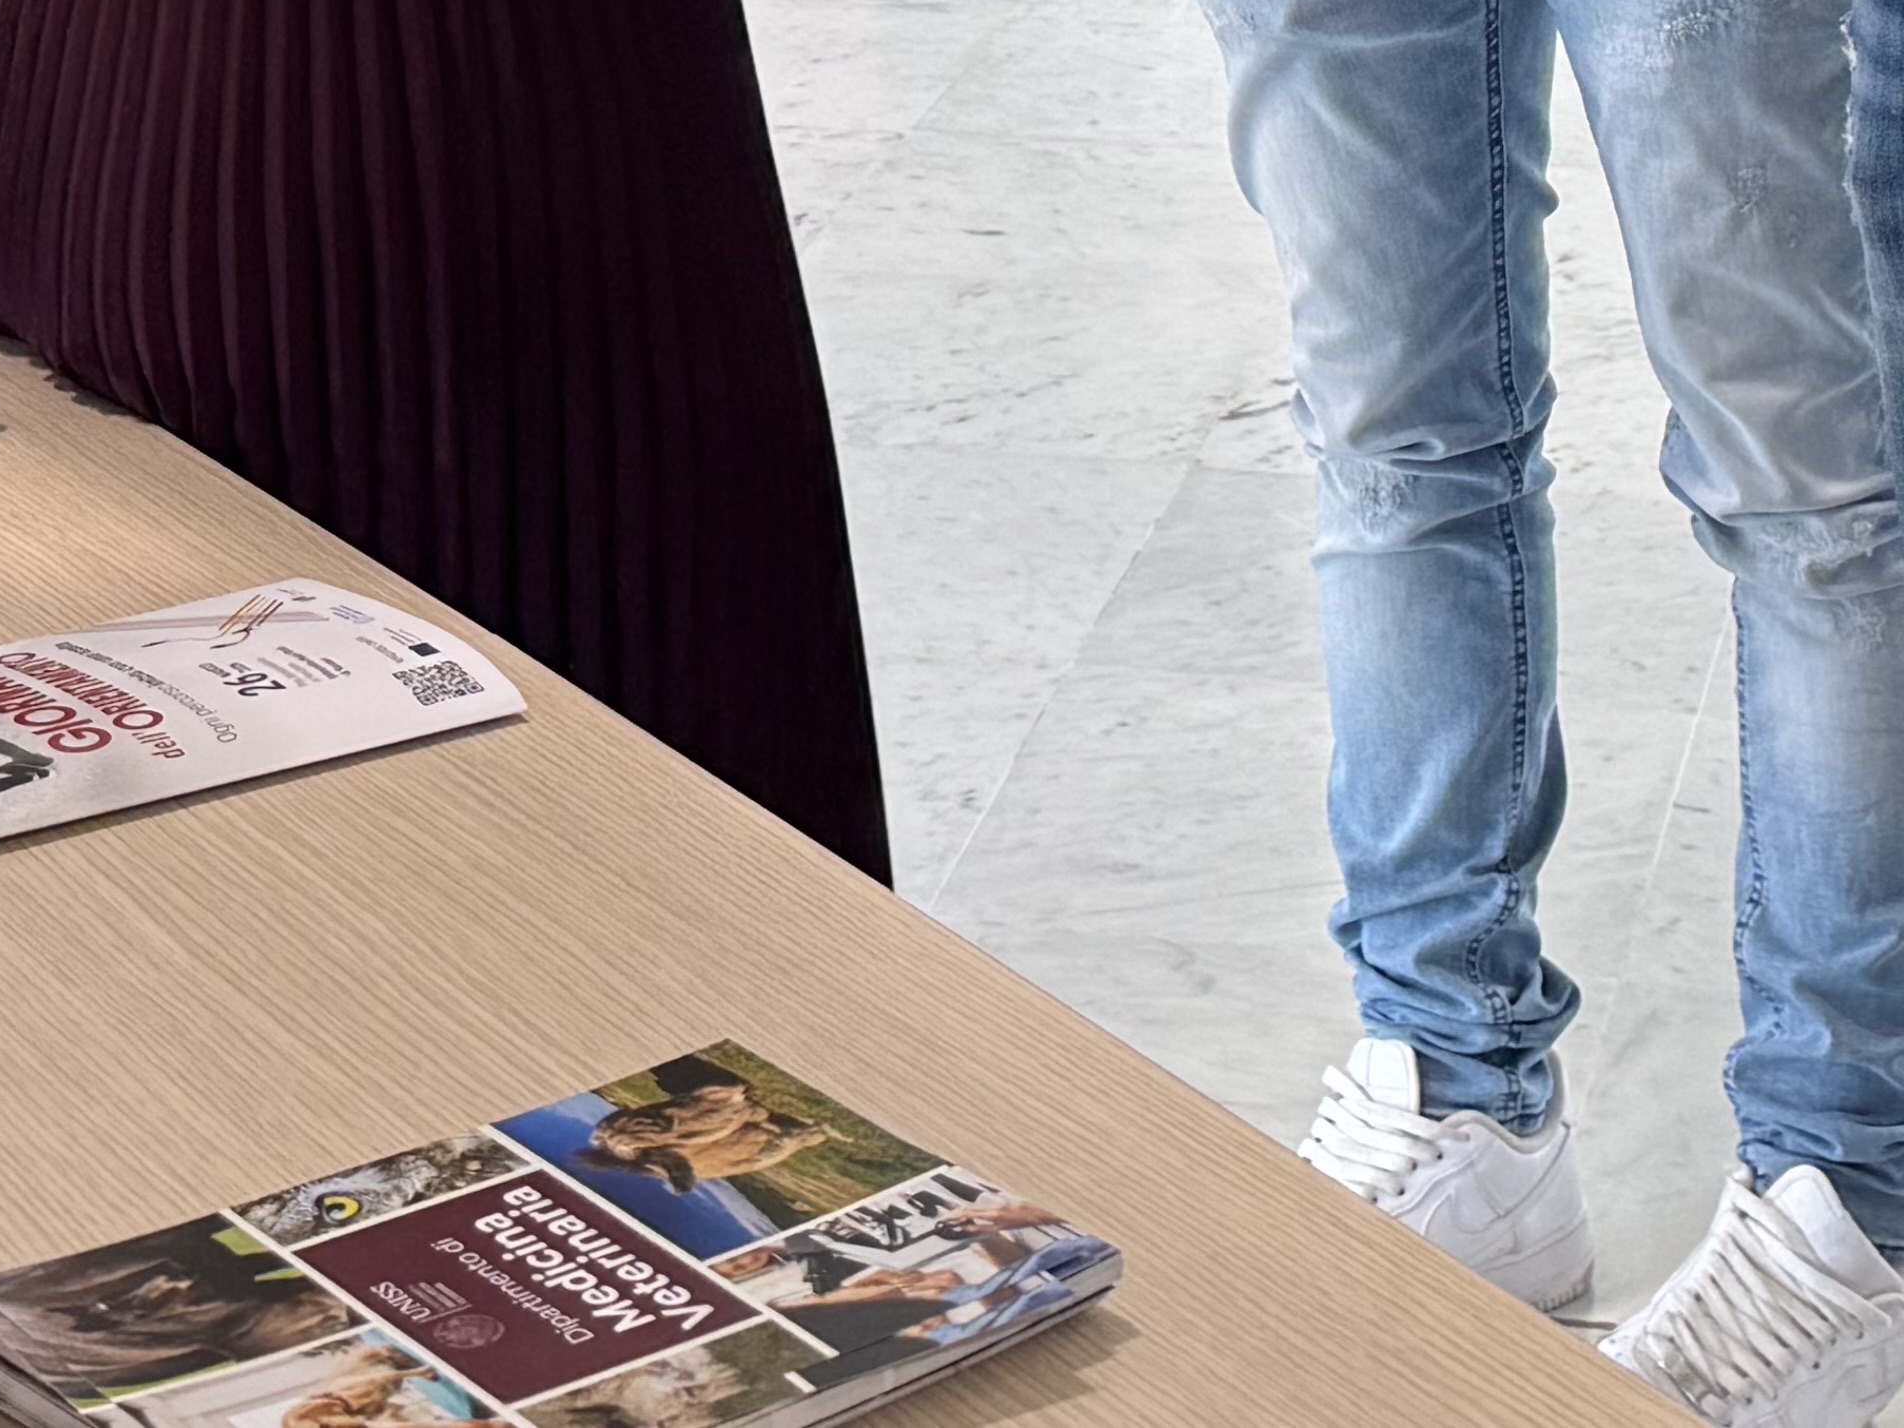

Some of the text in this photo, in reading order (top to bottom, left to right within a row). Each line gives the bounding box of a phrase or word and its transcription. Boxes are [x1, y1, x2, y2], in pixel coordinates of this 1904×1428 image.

[223, 672, 287, 697] 26
[429, 1236, 458, 1256] di
[474, 1211, 657, 1334] Medicina
[502, 1184, 716, 1332] Veterinaria
[370, 1280, 432, 1323] UNISS
[458, 1251, 596, 1346] Dipartimento
